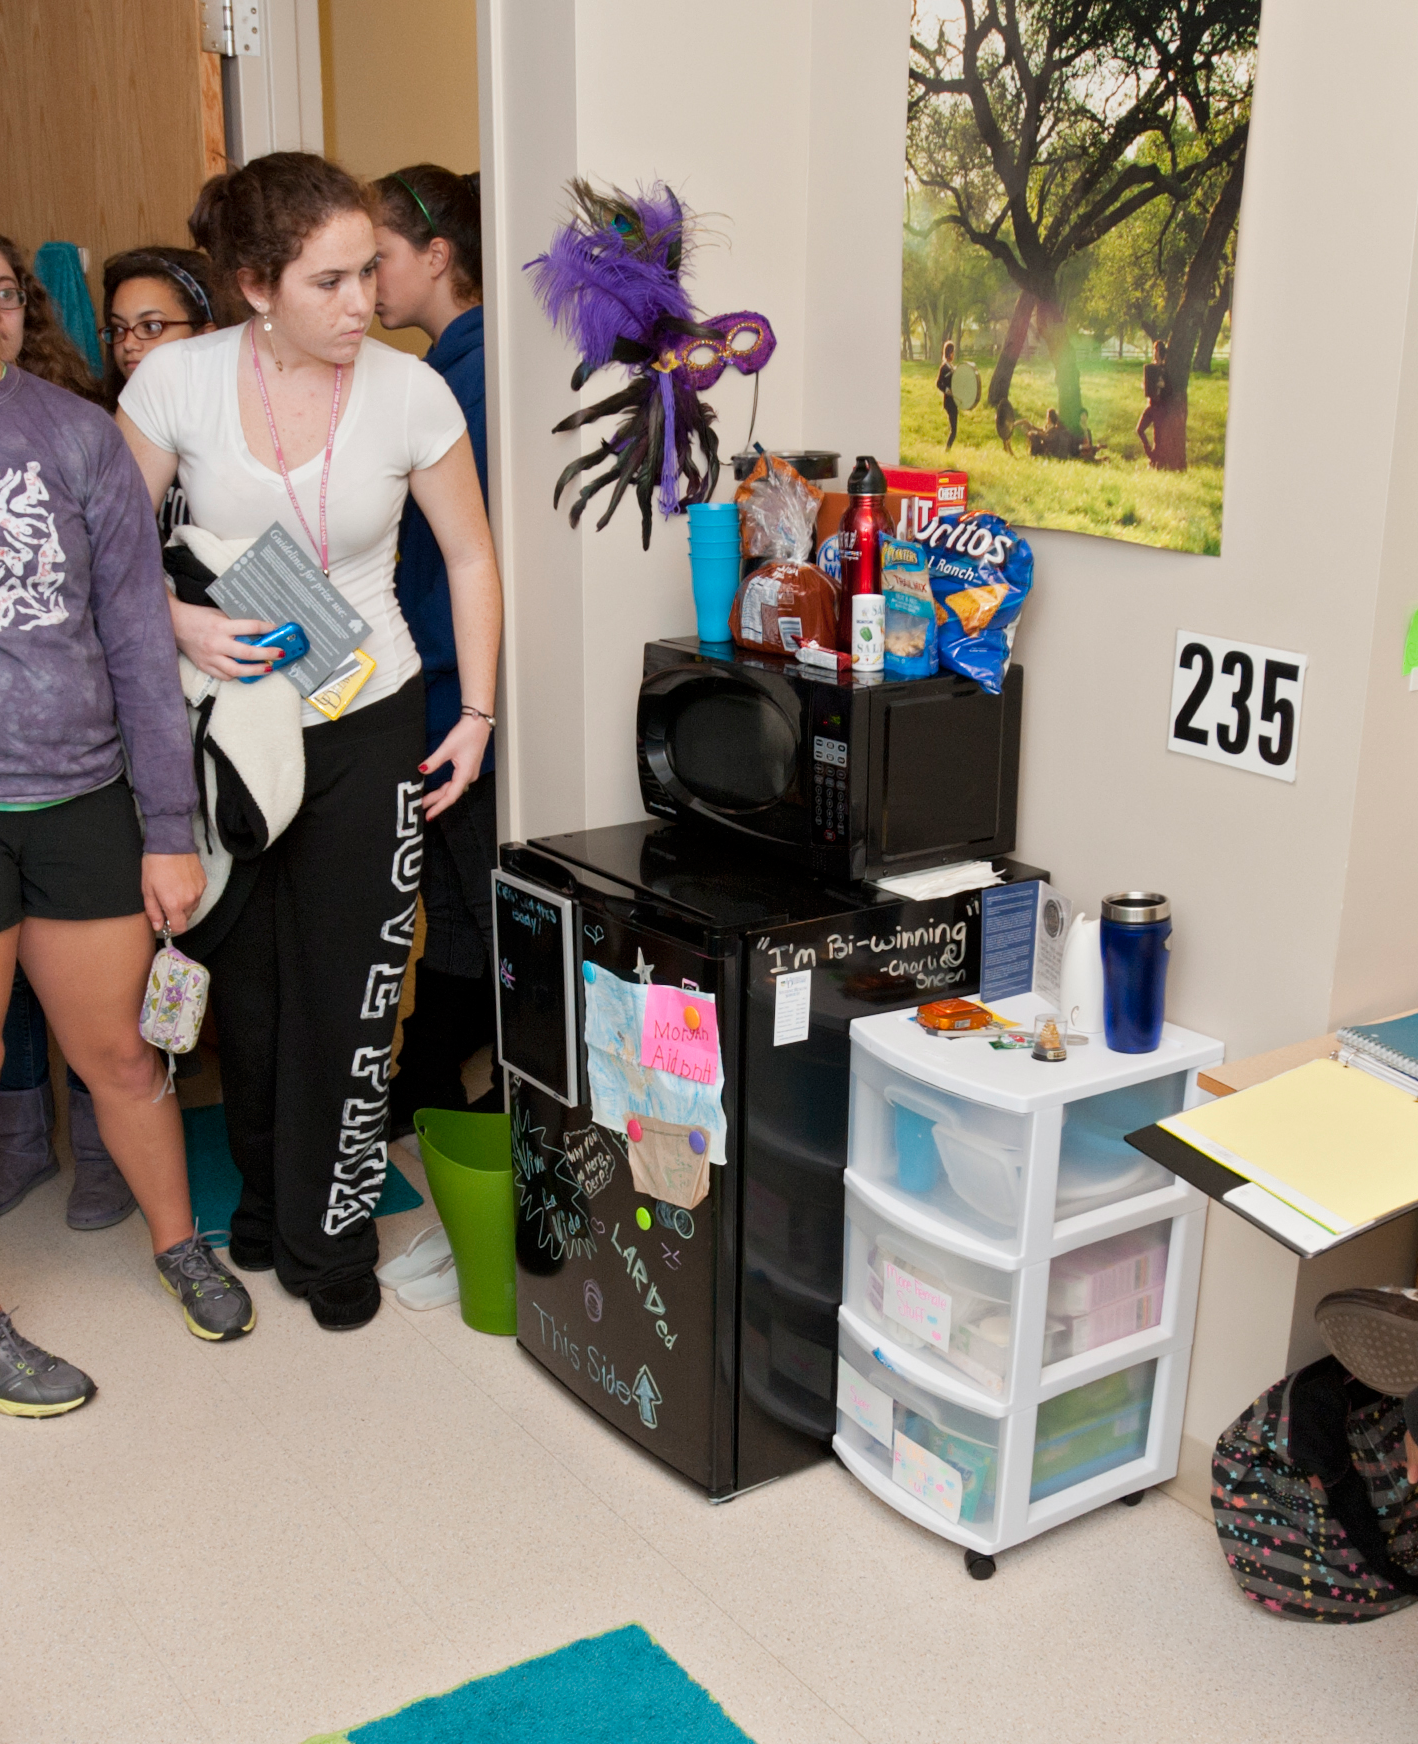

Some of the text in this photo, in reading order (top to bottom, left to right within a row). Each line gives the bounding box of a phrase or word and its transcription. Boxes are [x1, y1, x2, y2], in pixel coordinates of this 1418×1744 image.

[266, 527, 349, 619] Guidelines for prize use:
[914, 520, 1013, 564] oritos
[935, 558, 975, 582] Ranch
[1173, 642, 1300, 766] 235
[321, 1045, 392, 1237] PINK
[532, 1301, 632, 1405] This Side
